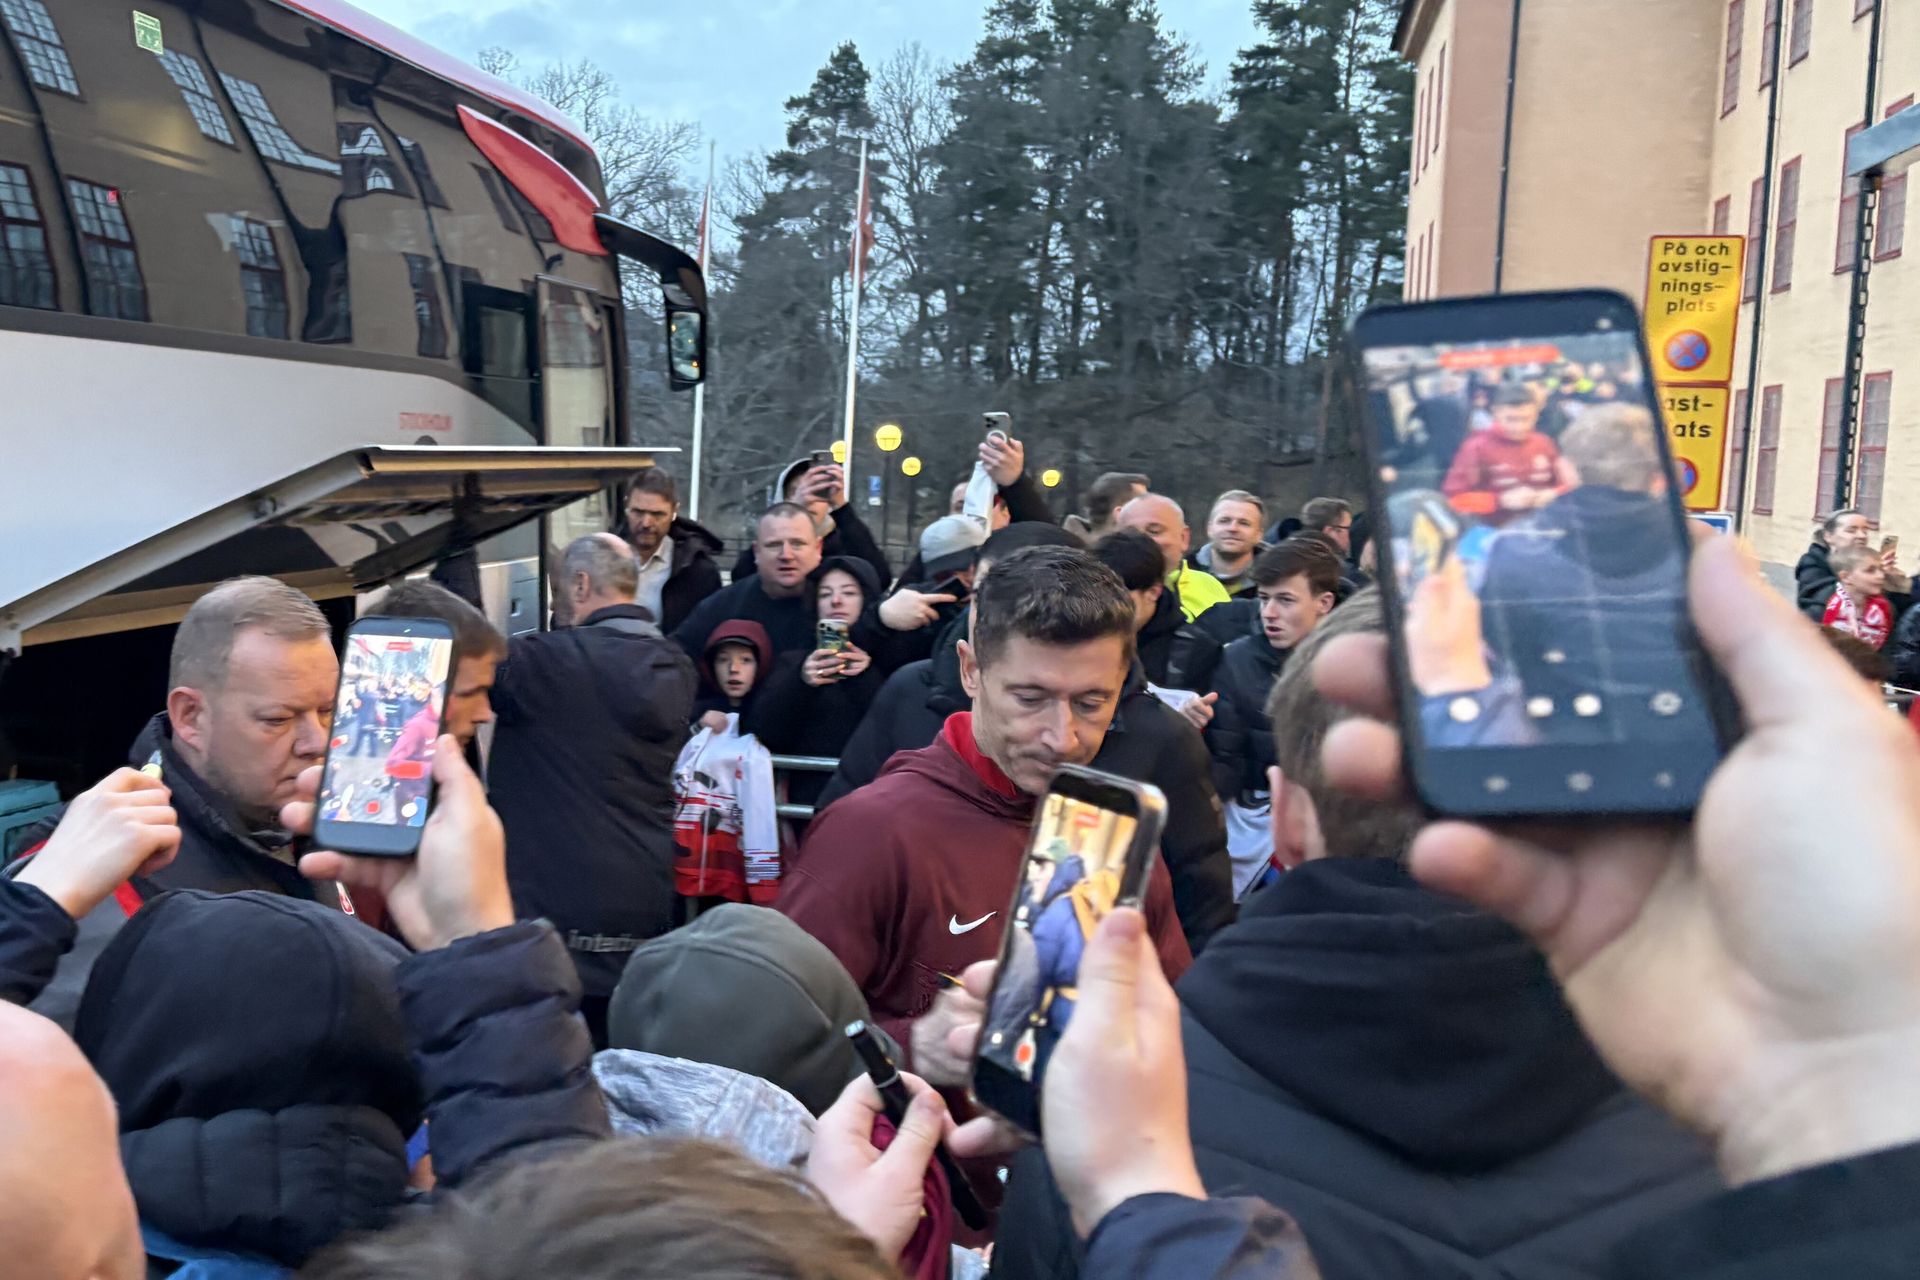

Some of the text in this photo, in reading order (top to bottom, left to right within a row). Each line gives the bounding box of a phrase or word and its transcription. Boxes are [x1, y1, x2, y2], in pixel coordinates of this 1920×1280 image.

[1663, 241, 1729, 256] På och
[1659, 259, 1733, 276] avstig-
[1661, 279, 1726, 296] nings-
[1666, 299, 1717, 315] plats
[1664, 395, 1714, 412] ast-
[1674, 421, 1713, 438] ats
